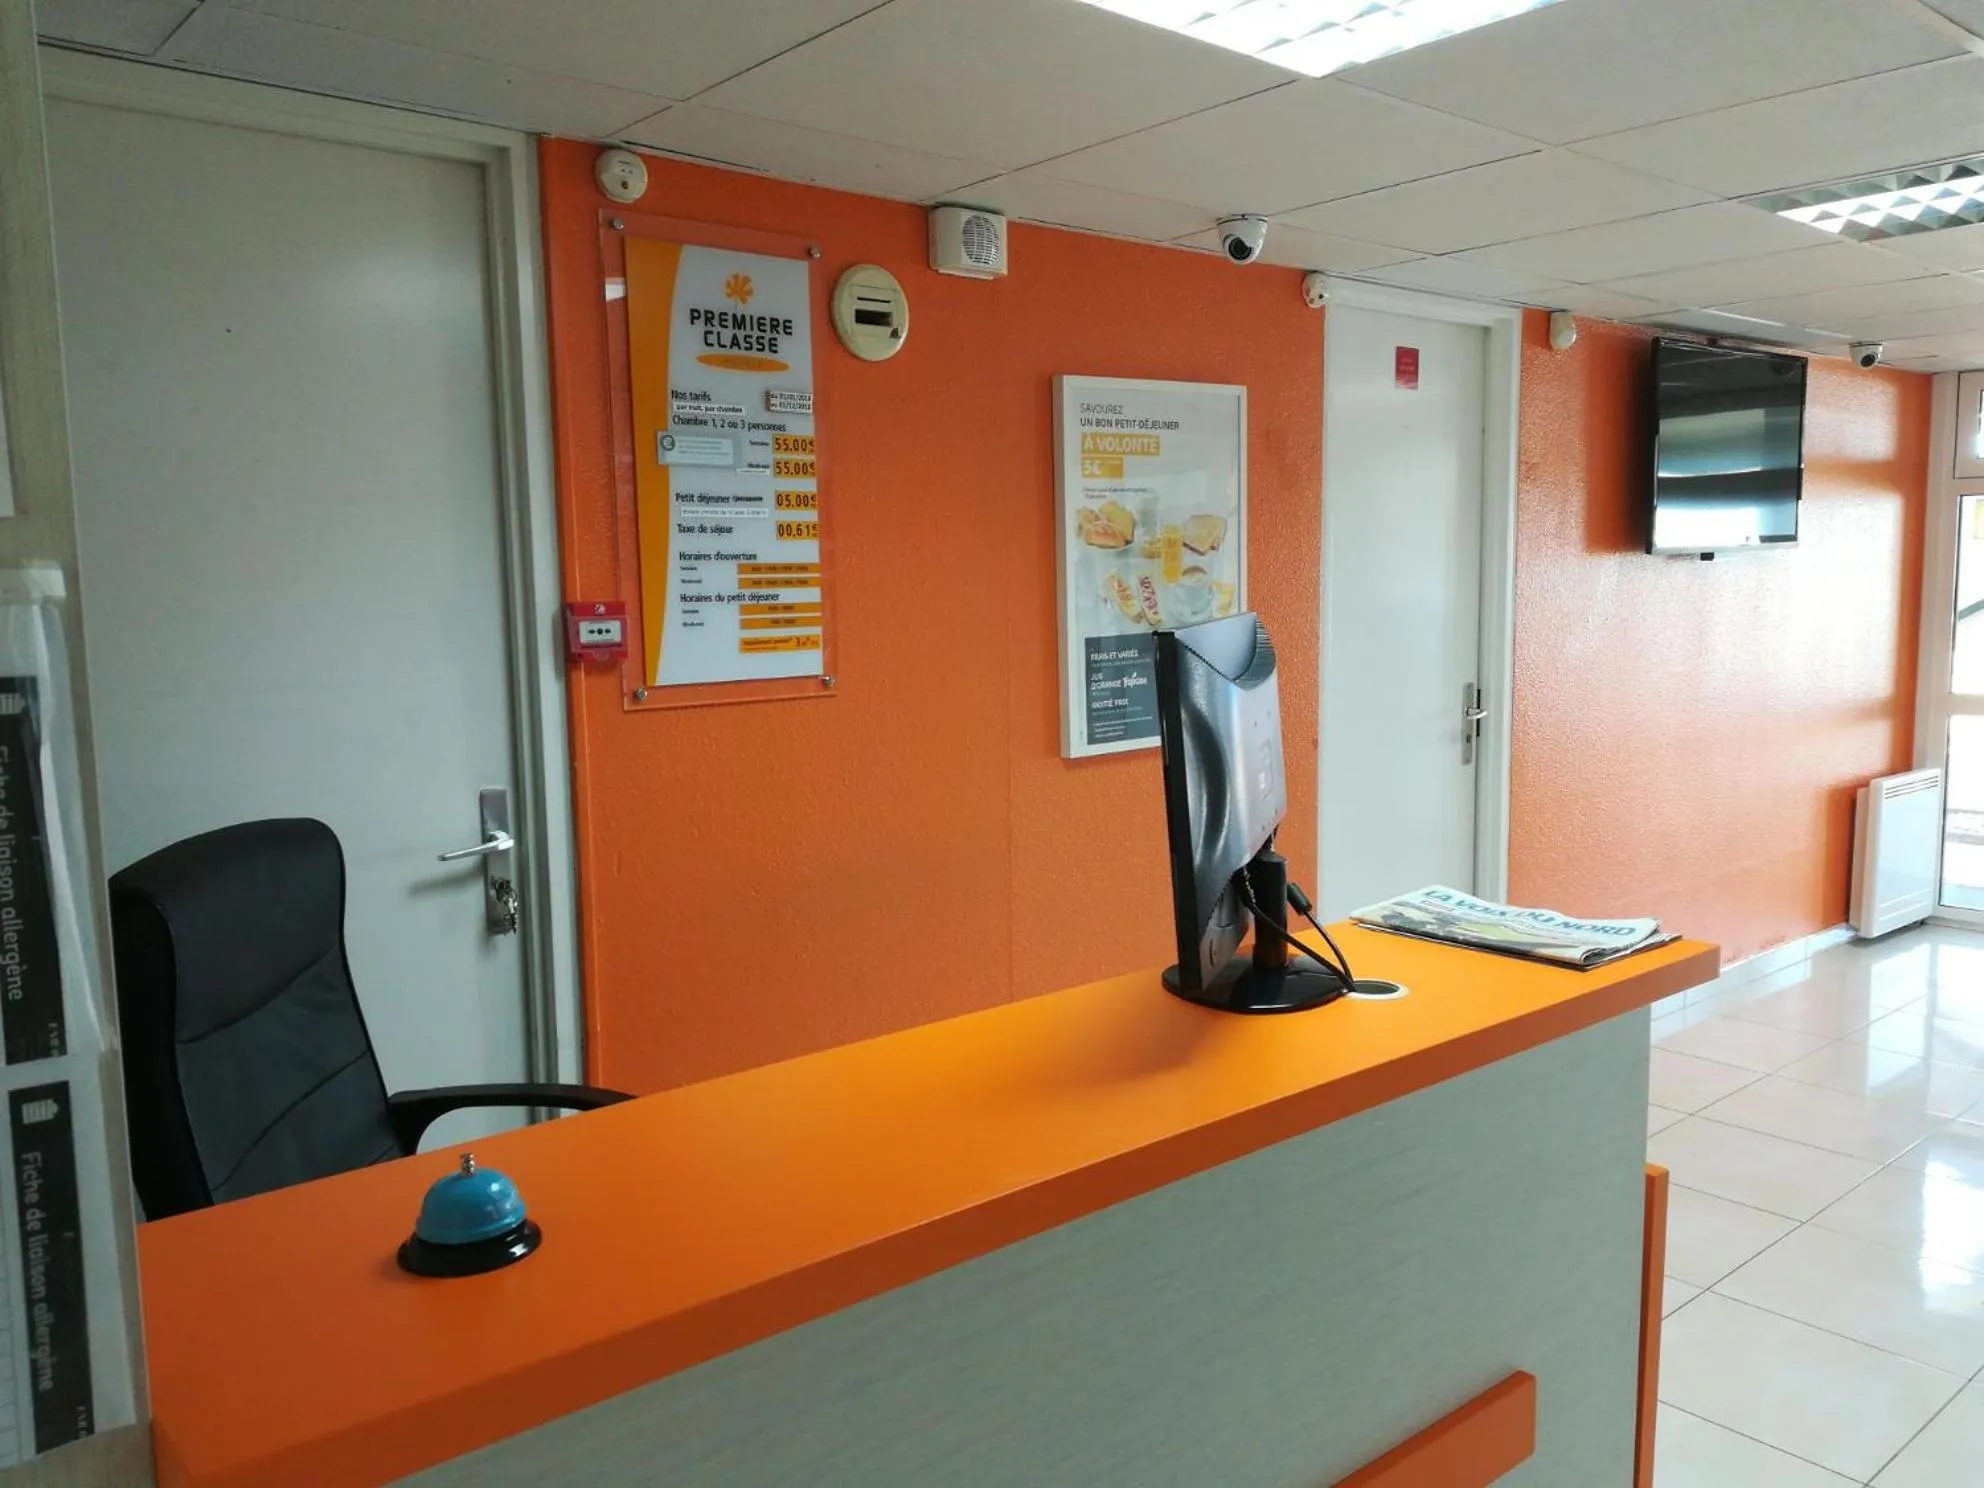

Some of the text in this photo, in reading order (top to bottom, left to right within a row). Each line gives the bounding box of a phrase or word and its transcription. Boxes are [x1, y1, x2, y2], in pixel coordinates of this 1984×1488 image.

[689, 308, 793, 336] PREMIERE
[703, 330, 779, 354] CLASSE
[671, 389, 711, 401] Nos tarifs
[1080, 403, 1123, 415] SAVOUREZ
[672, 415, 708, 427] Chambre
[720, 418, 725, 428] 2
[740, 419, 745, 429] 3
[748, 421, 786, 432] personnes
[1080, 418, 1180, 431] UN BON PETIT-DÉJEUNER
[675, 492, 695, 502] Petit
[677, 523, 734, 536] Taxe de séjour
[679, 551, 758, 561] Horaires d'ouverture
[680, 593, 712, 603] Horaires
[715, 592, 725, 602] du
[727, 592, 746, 604] petit
[1422, 890, 1453, 901] LA
[1554, 921, 1636, 935] NORD
[0, 906, 28, 1001] allergène
[20, 1151, 59, 1392] Fiche de liaison allergène
